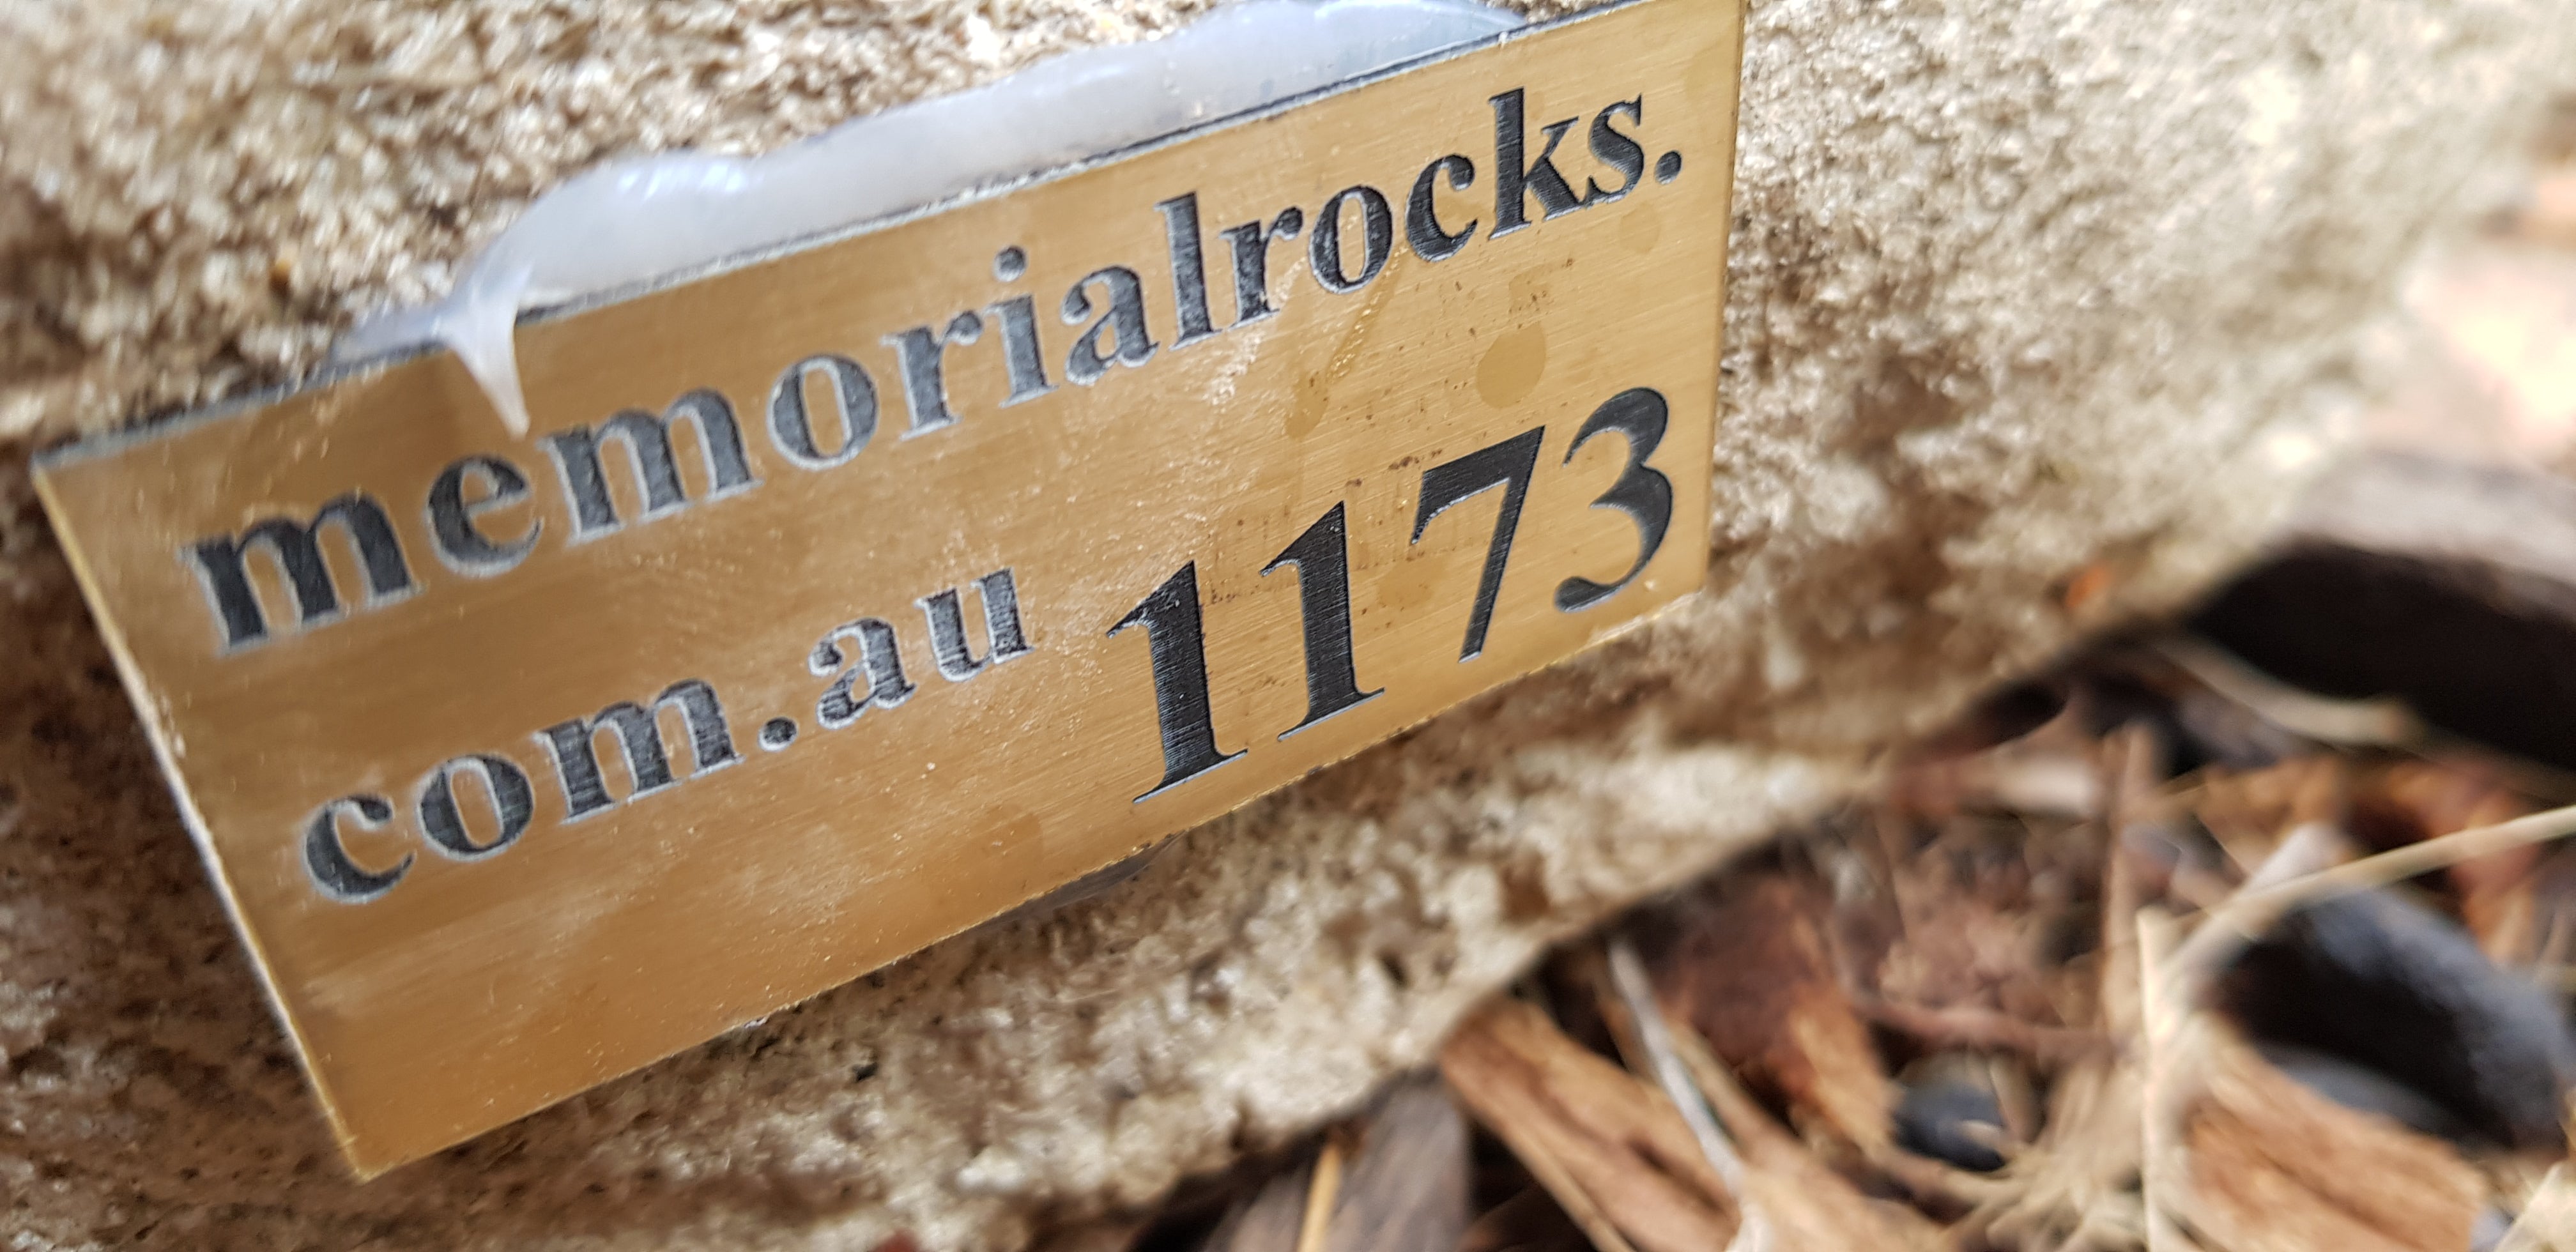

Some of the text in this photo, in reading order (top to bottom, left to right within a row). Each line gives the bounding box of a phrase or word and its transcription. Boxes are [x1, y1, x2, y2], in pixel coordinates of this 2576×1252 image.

[177, 86, 1682, 655] memorialrocks.
[300, 386, 1673, 903] com.au 1173
